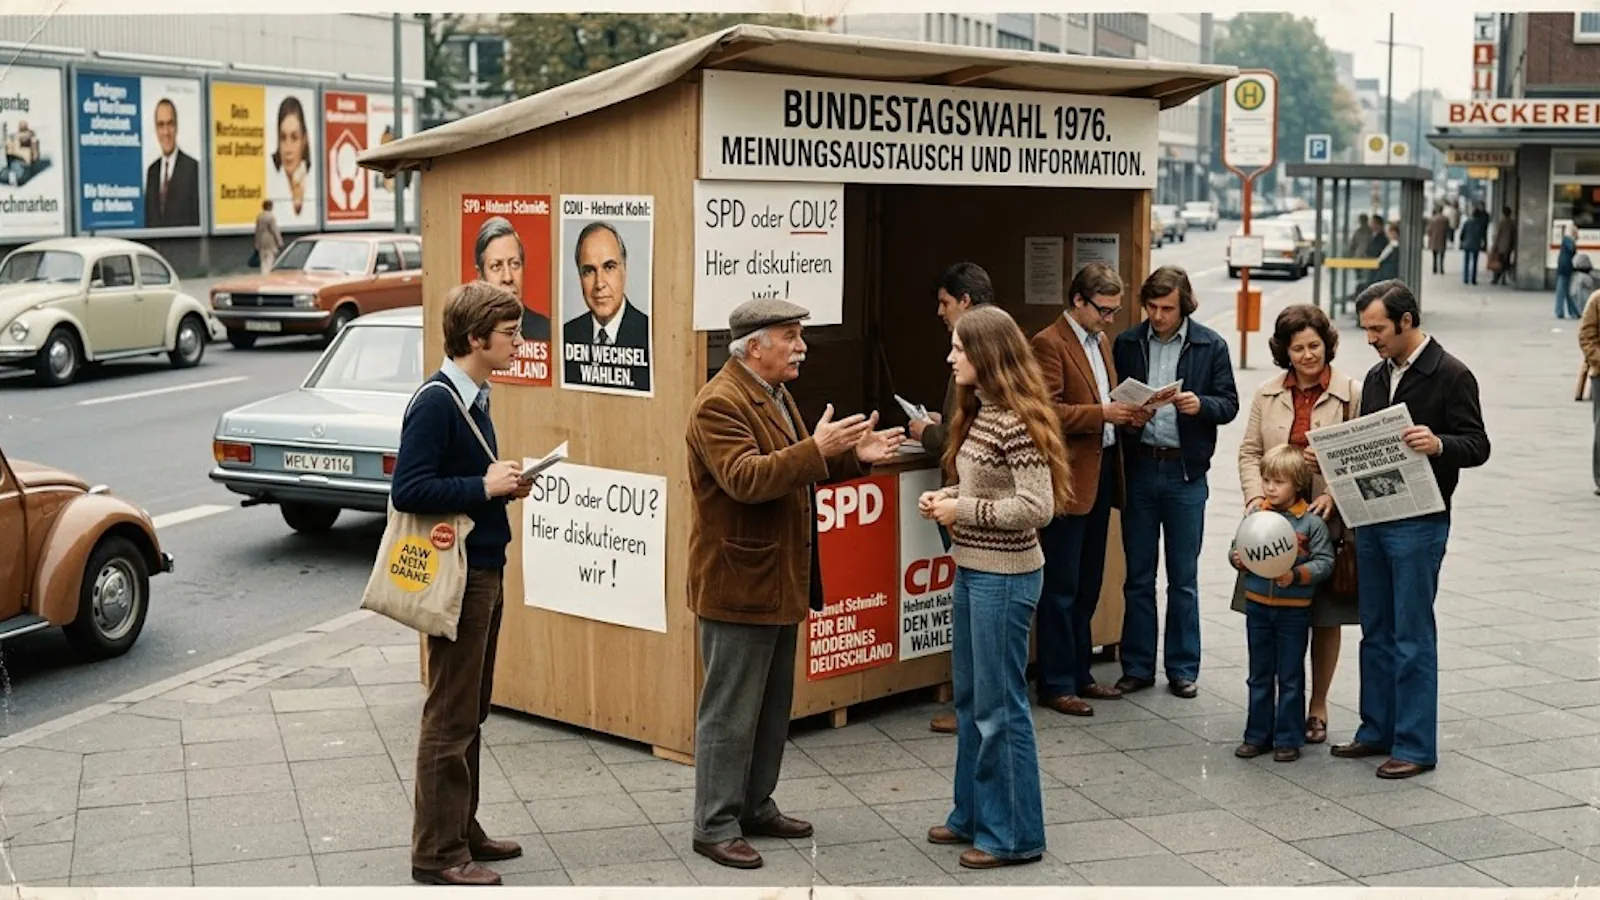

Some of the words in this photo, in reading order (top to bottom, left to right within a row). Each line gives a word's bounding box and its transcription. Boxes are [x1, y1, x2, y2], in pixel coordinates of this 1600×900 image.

[784, 88, 1048, 139] BUNDESTAGSWAHL
[1053, 105, 1112, 142] 1976.
[721, 136, 963, 172] MEINUNGSAUSTAUSCH
[971, 146, 1011, 173] UND
[1018, 148, 1146, 176] INFORMATION.
[1312, 140, 1325, 157] P
[463, 199, 480, 214] SPD
[564, 201, 583, 215] CDU
[591, 201, 624, 216] Helmut
[626, 201, 651, 217] Kohl:
[705, 199, 745, 229] SPD
[751, 204, 784, 229] oder
[789, 199, 838, 230] CDU?
[705, 250, 740, 276] Hier
[746, 248, 832, 275] diskutieren
[565, 343, 590, 362] DEN
[592, 345, 648, 367] WECHSEL
[580, 363, 635, 386] WÄHLEN.
[531, 474, 571, 505] SPD
[575, 487, 602, 510] oder
[816, 483, 884, 533] SPD
[531, 513, 560, 541] Hier
[564, 520, 646, 556] diskutieren
[1245, 536, 1294, 562] WAHL
[398, 554, 427, 571] NEIN
[904, 555, 957, 596] CD
[845, 592, 888, 613] Schmidt:
[836, 613, 857, 632] EIN
[903, 613, 928, 635] DEN
[810, 628, 876, 657] MODERNES
[911, 627, 953, 652] WÄHLE
[810, 643, 893, 675] DEUTSCHLAND
